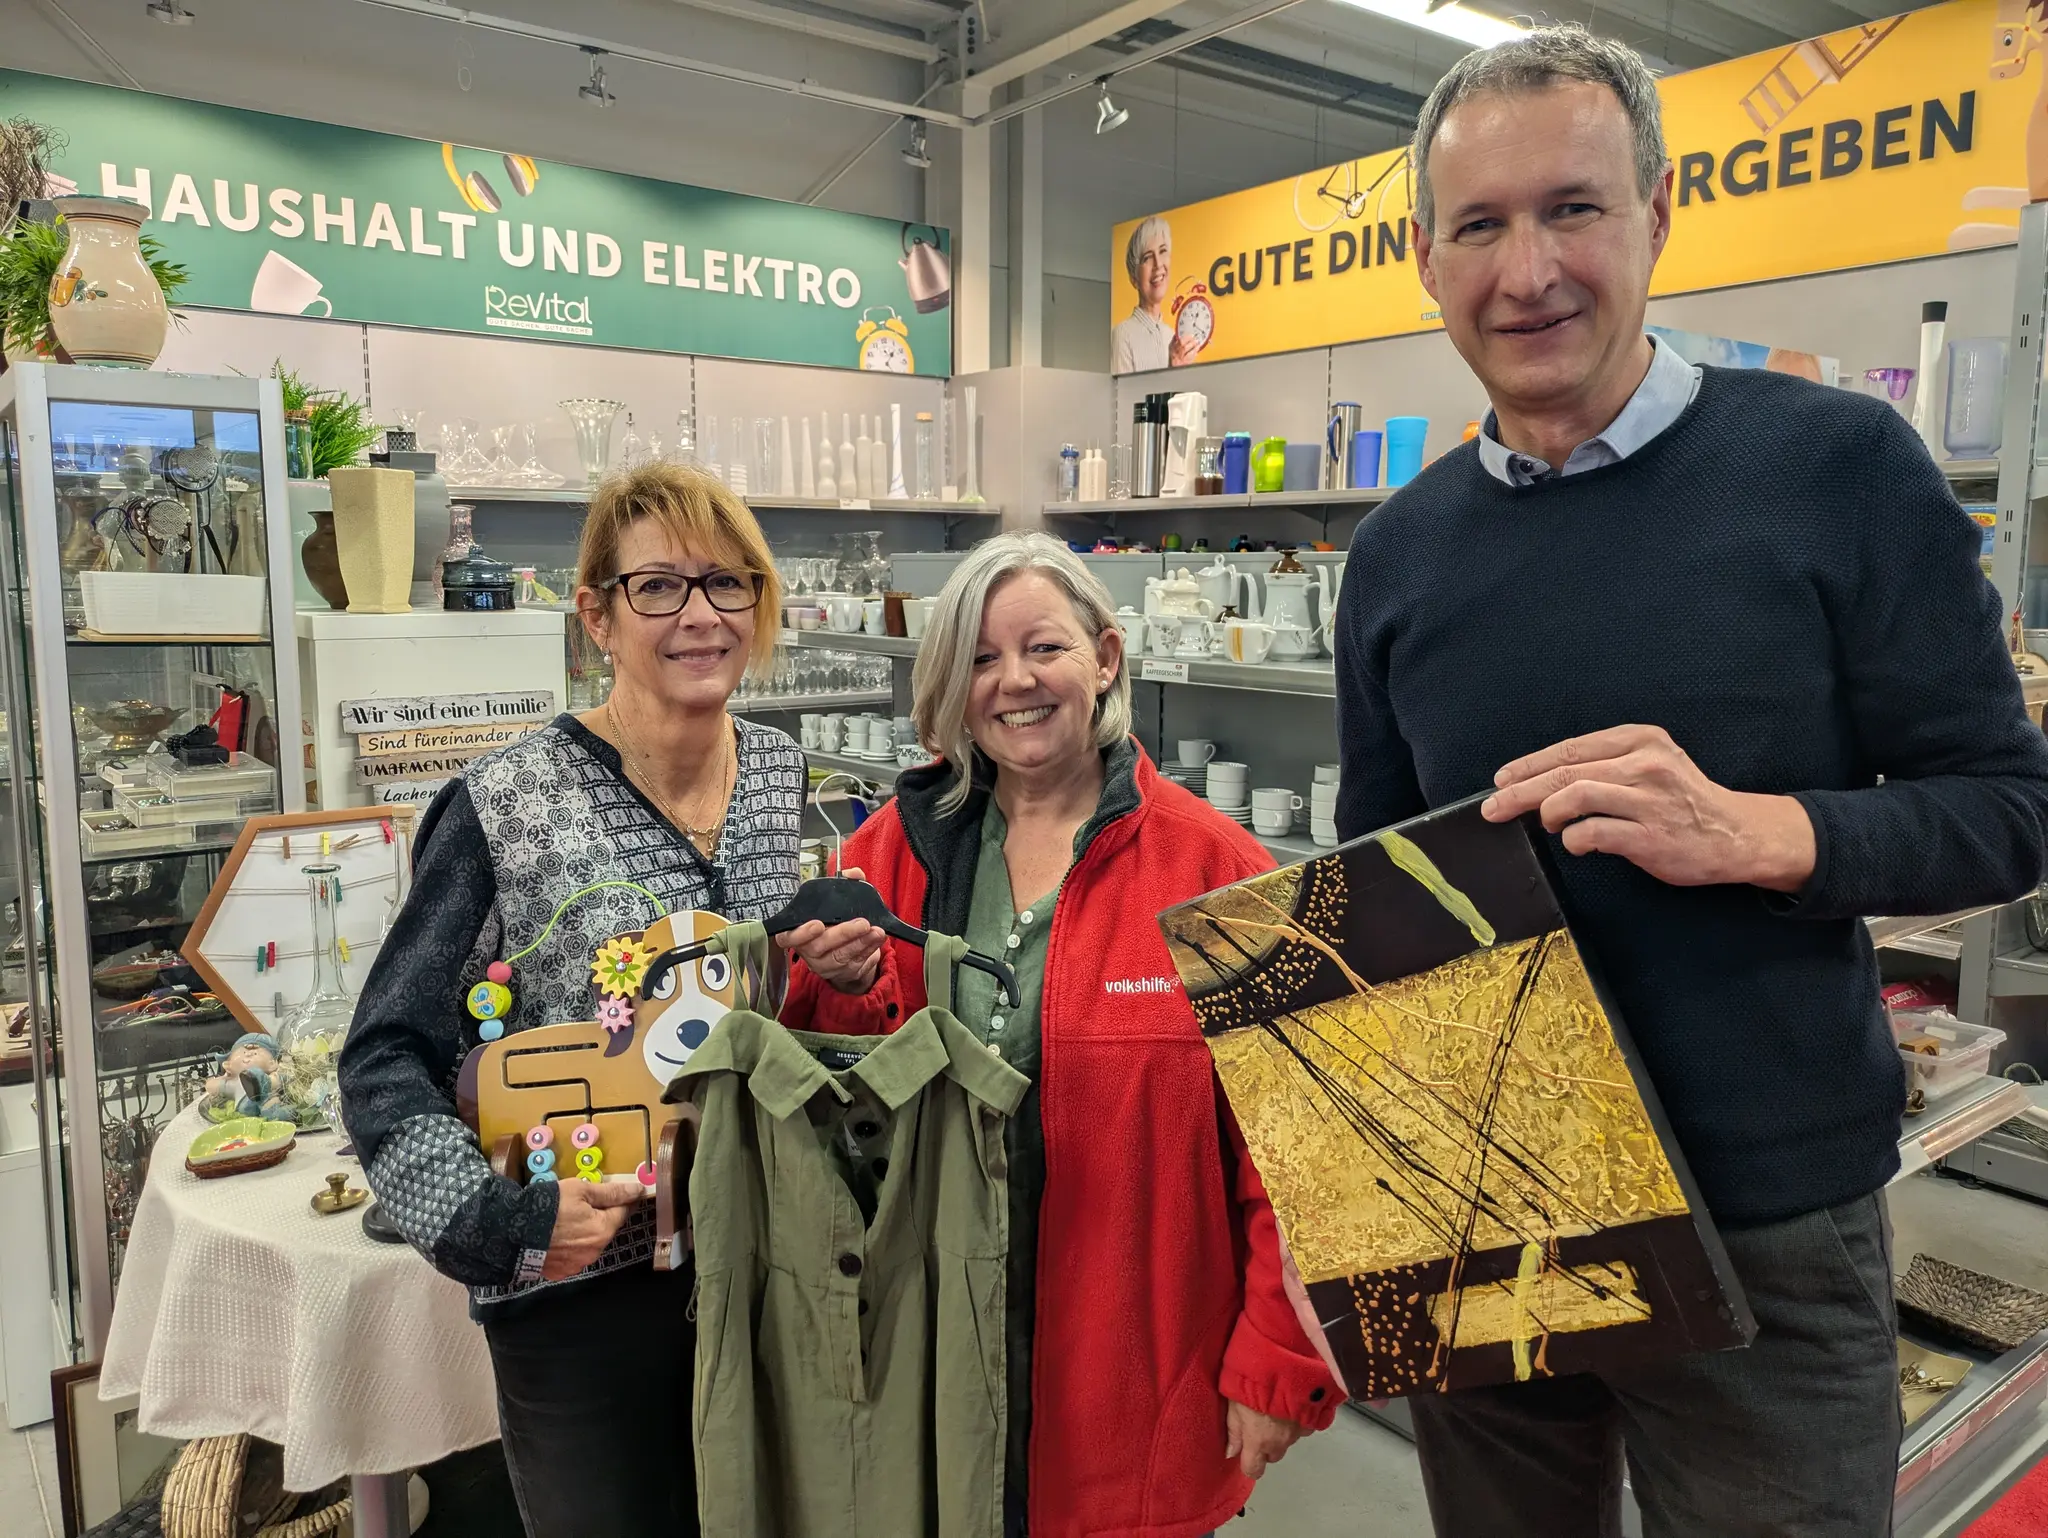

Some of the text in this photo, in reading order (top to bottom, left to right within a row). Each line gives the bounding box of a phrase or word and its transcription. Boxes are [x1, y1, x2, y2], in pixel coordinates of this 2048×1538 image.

[1678, 90, 1976, 207] RGEBEN
[101, 163, 861, 308] HAUSHALT UND ELEKTRO
[1209, 217, 1406, 297] GUTE DIN
[485, 285, 592, 324] ReVital
[351, 698, 547, 725] Wir sind eine Familie
[368, 734, 406, 751] Sind
[414, 728, 513, 748] füreinander
[363, 759, 443, 778] UMARMEN
[383, 787, 438, 802] Lachen
